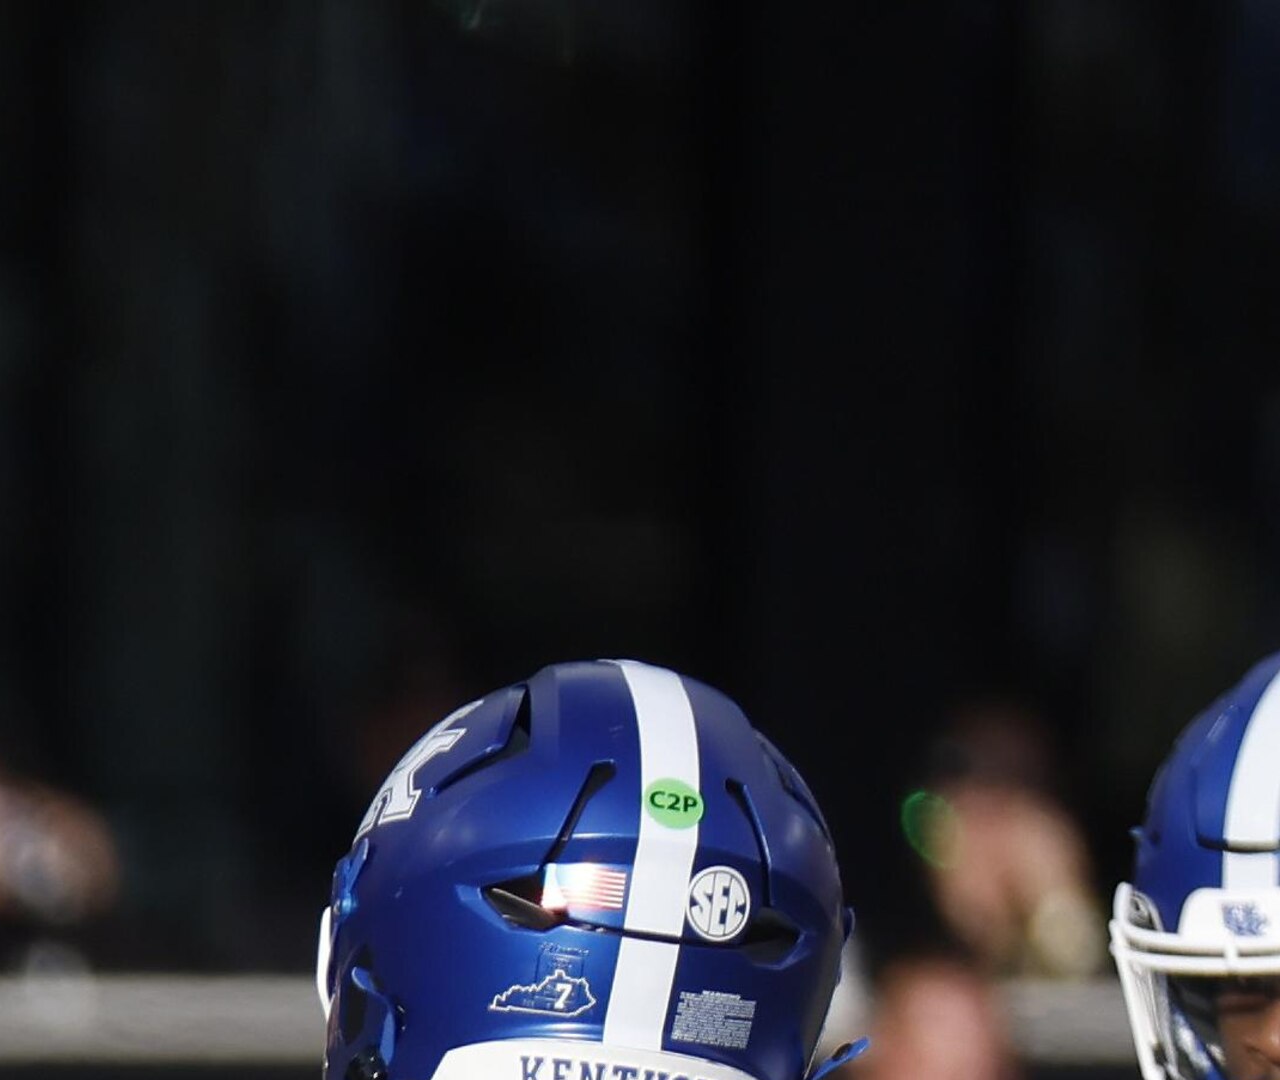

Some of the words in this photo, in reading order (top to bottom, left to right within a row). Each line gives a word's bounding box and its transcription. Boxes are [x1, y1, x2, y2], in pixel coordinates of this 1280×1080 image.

[649, 790, 698, 812] C2P
[690, 871, 747, 936] SEC
[554, 983, 572, 1010] 7
